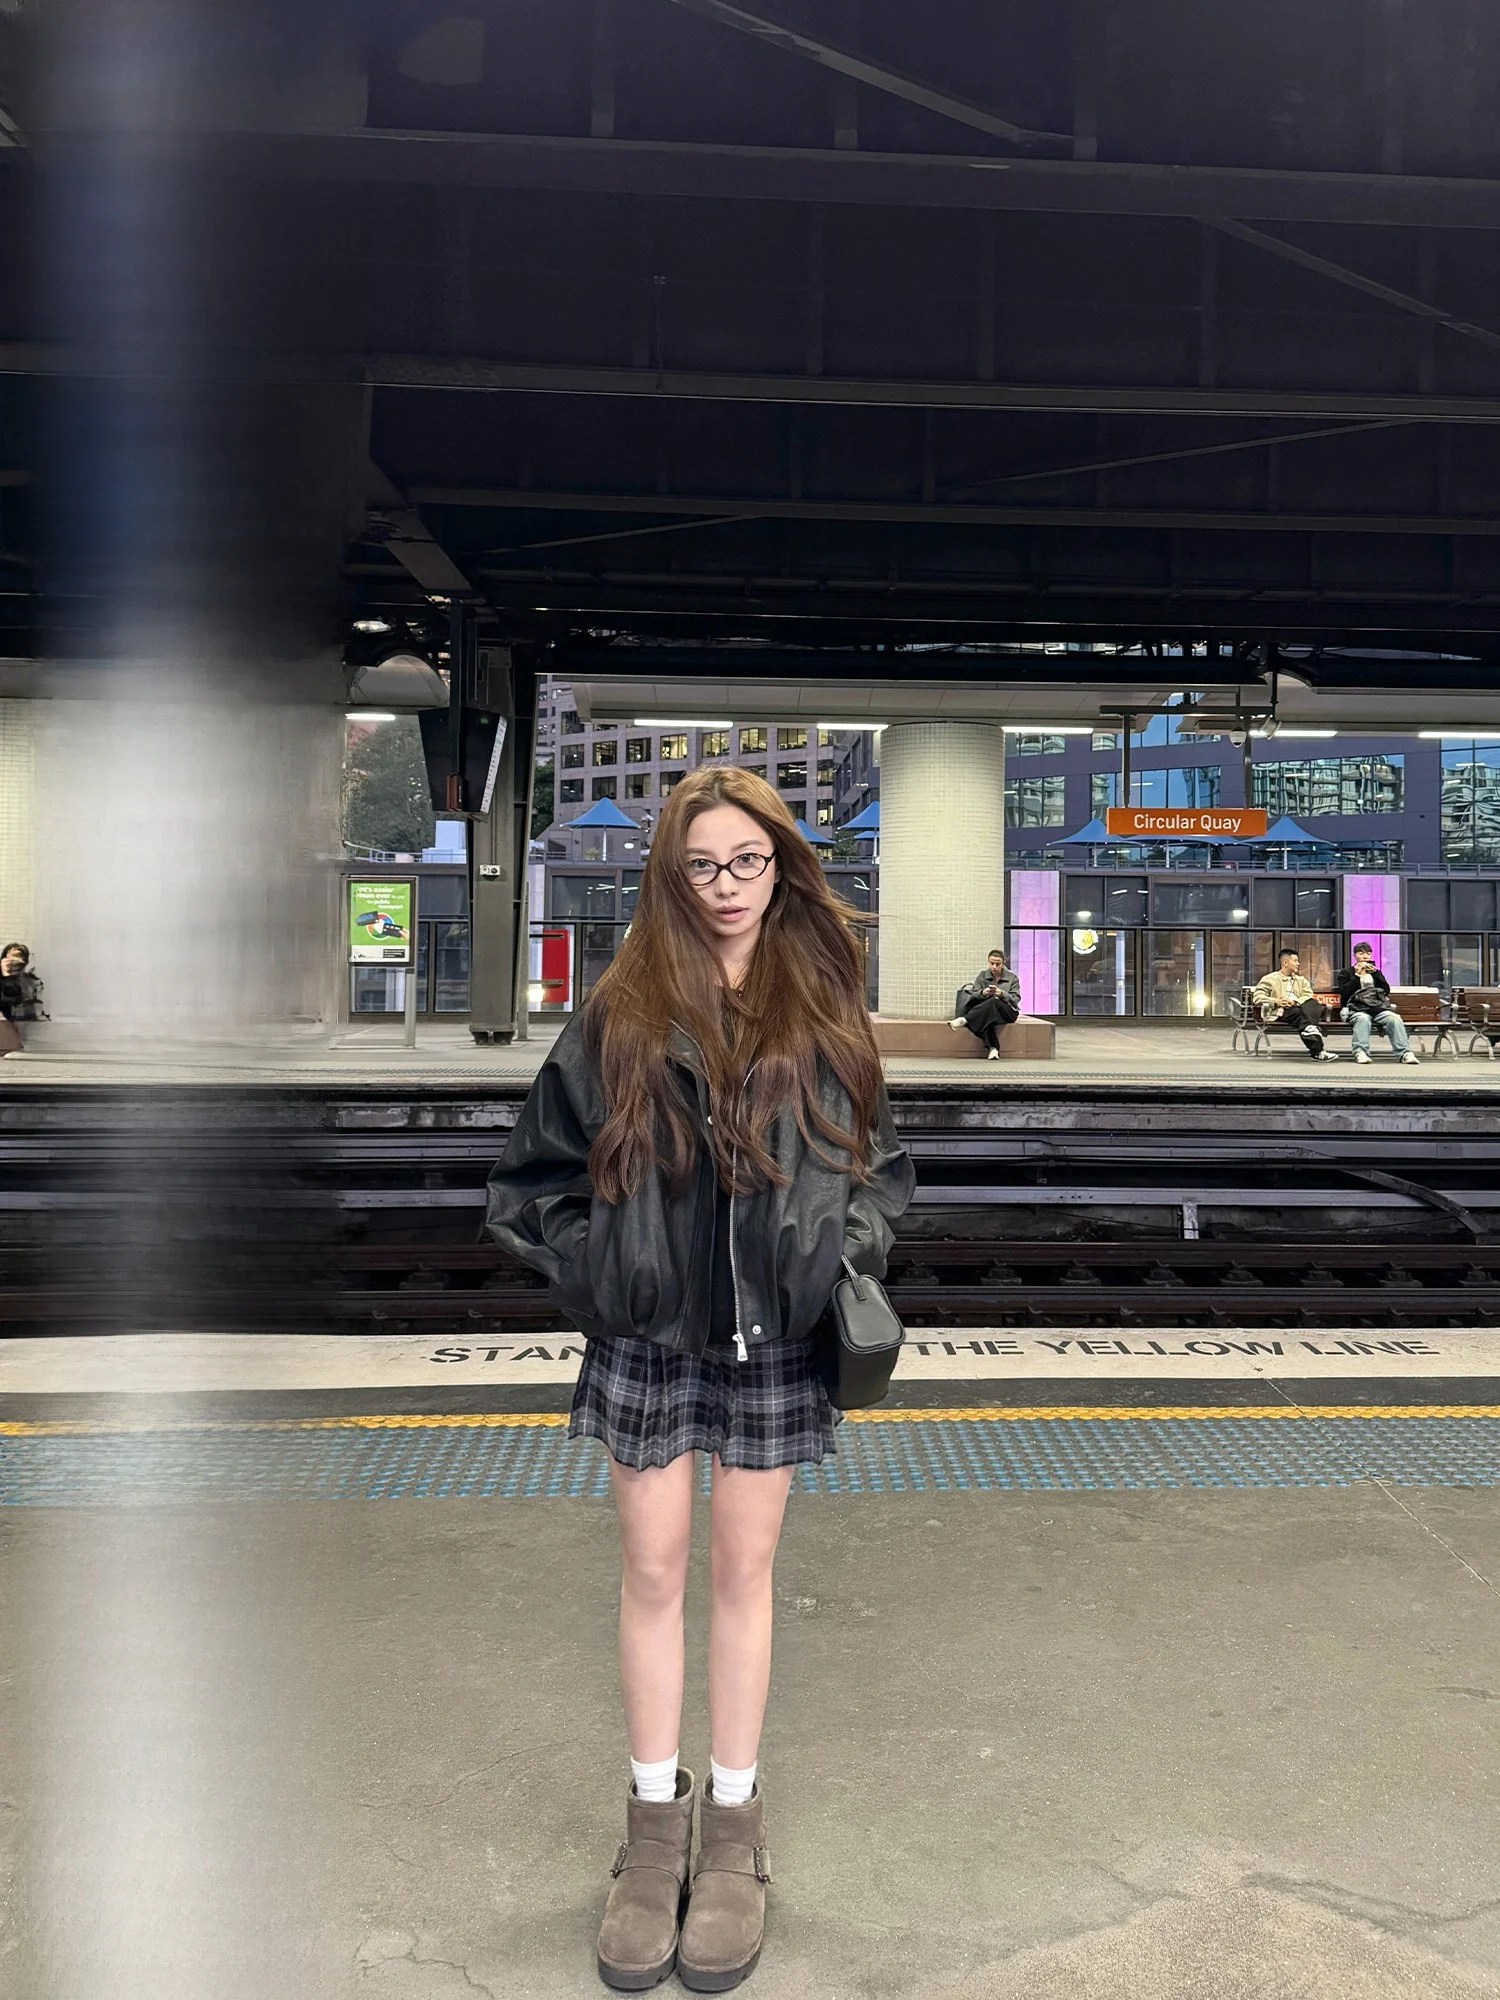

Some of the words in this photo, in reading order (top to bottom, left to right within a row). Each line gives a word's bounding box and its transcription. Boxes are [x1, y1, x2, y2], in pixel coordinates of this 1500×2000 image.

[1134, 814, 1197, 829] Circular
[1200, 814, 1241, 833] Quay
[902, 1341, 1024, 1355] THE
[1033, 1341, 1284, 1355] YELLOW
[1299, 1341, 1440, 1355] LINE
